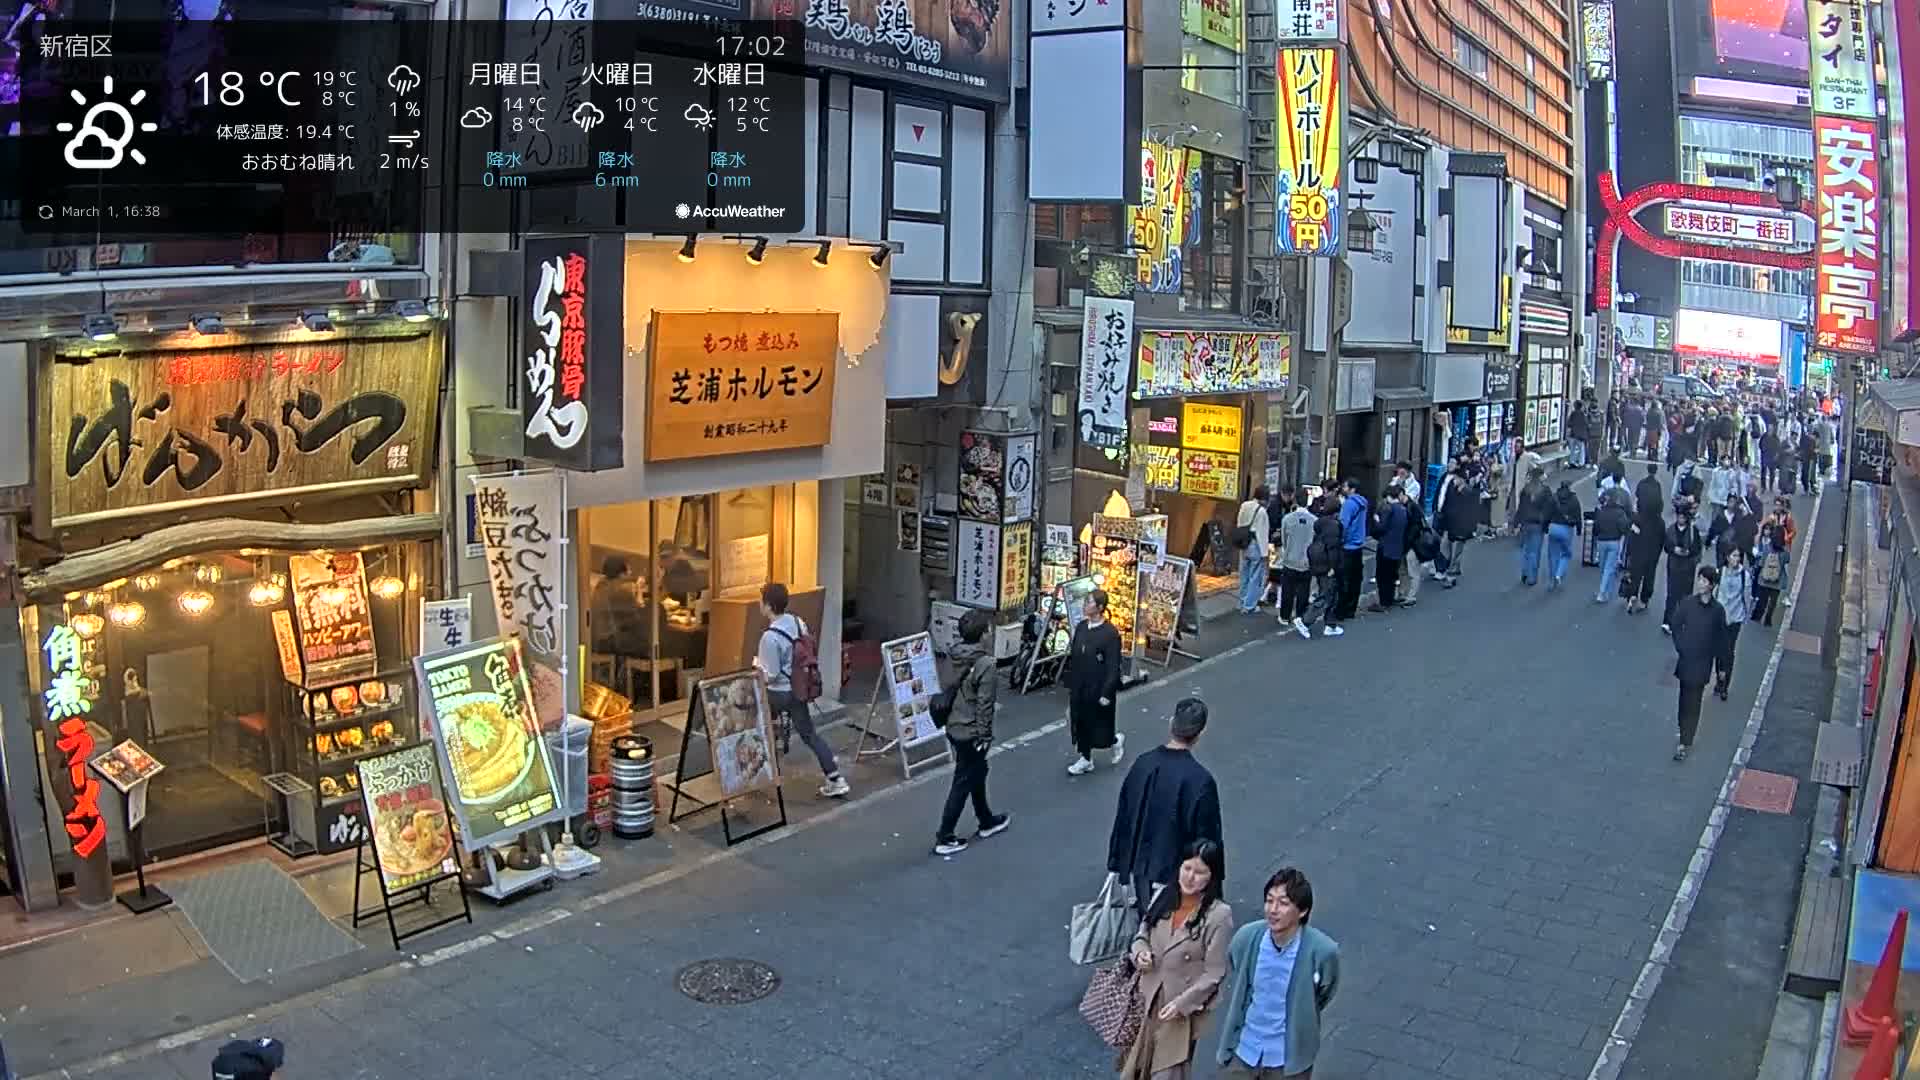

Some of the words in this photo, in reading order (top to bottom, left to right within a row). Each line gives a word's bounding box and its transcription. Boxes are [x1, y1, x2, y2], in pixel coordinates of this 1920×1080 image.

[1819, 83, 1869, 95] RESTAURANT
[1832, 96, 1856, 110] 3F
[1295, 54, 1322, 188] ハイボール
[1671, 210, 1791, 241] 歌舞伎町一番街
[1819, 125, 1876, 328] 安楽亭
[561, 252, 587, 400] 東京豚骨
[703, 333, 749, 354] もつ焼
[756, 331, 800, 352] 煮込み
[1818, 332, 1838, 346] 2F
[669, 366, 825, 406] 芝浦ホルモン
[66, 377, 407, 491] ばんから
